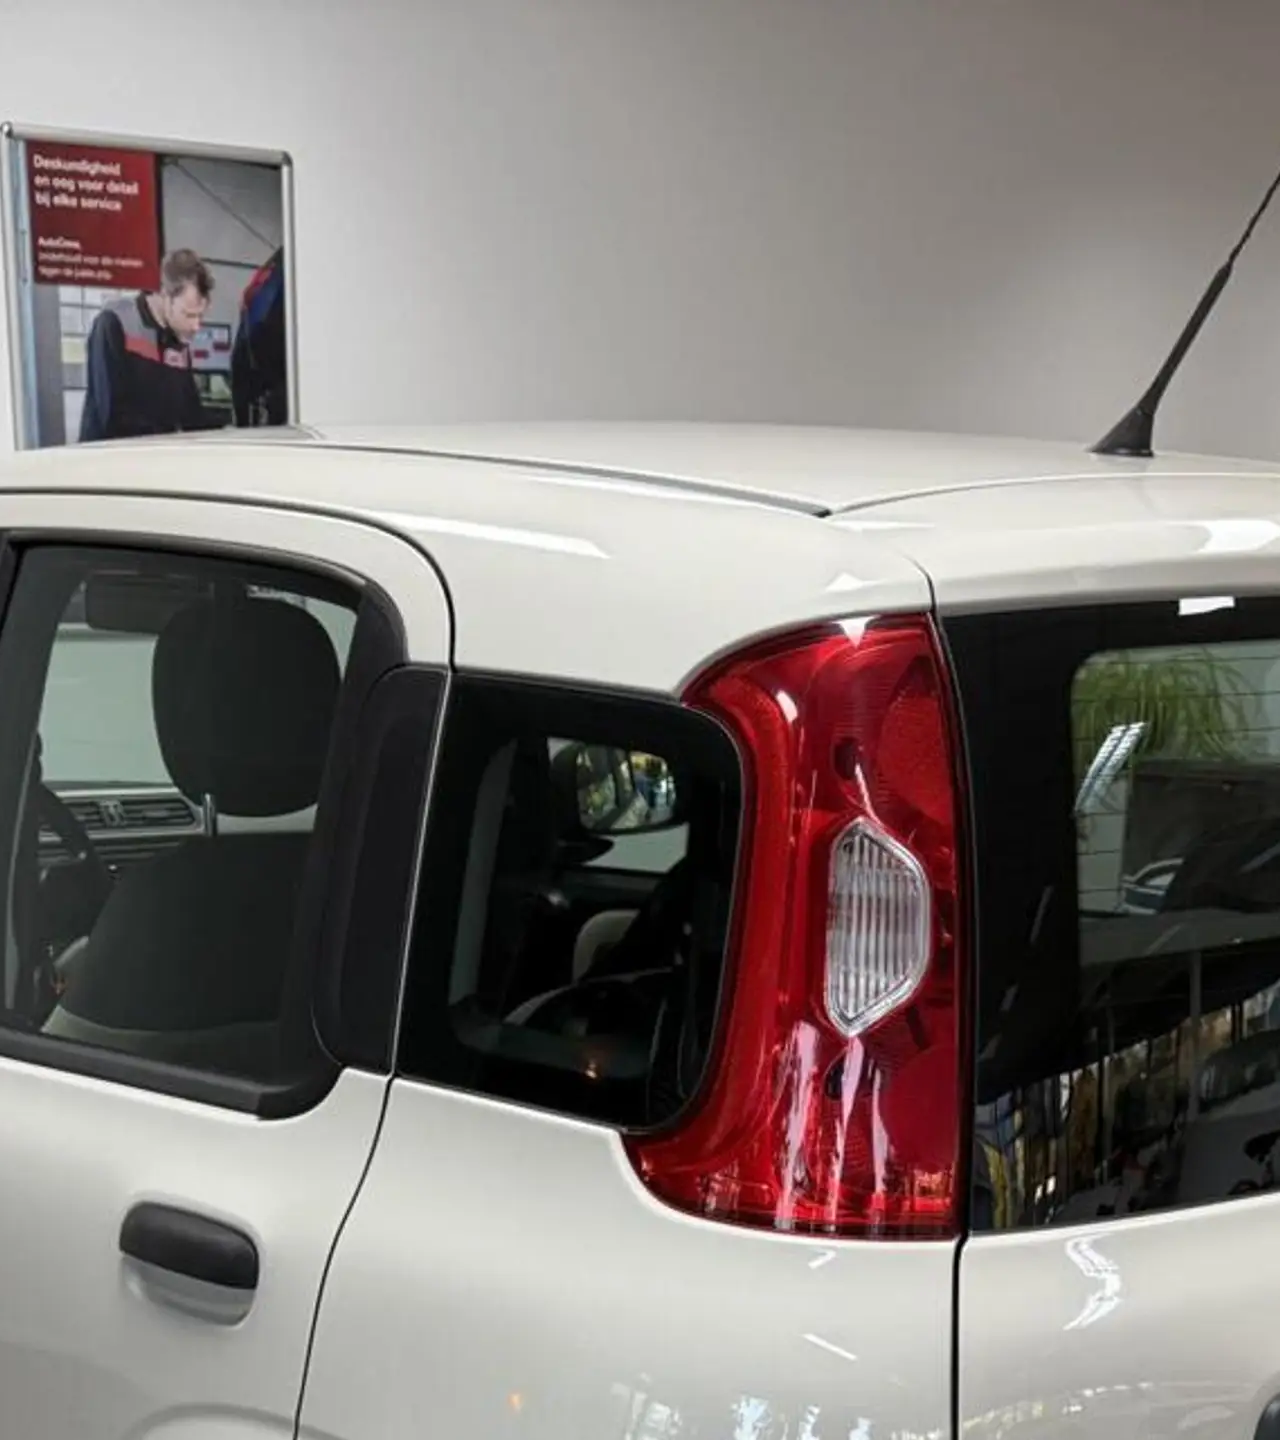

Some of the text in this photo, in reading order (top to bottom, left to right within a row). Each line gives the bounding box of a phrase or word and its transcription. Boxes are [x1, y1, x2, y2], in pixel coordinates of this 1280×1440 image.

[33, 154, 121, 176] Deskundigheid
[34, 175, 139, 195] en oog voor detail
[35, 191, 123, 212] bij elke service
